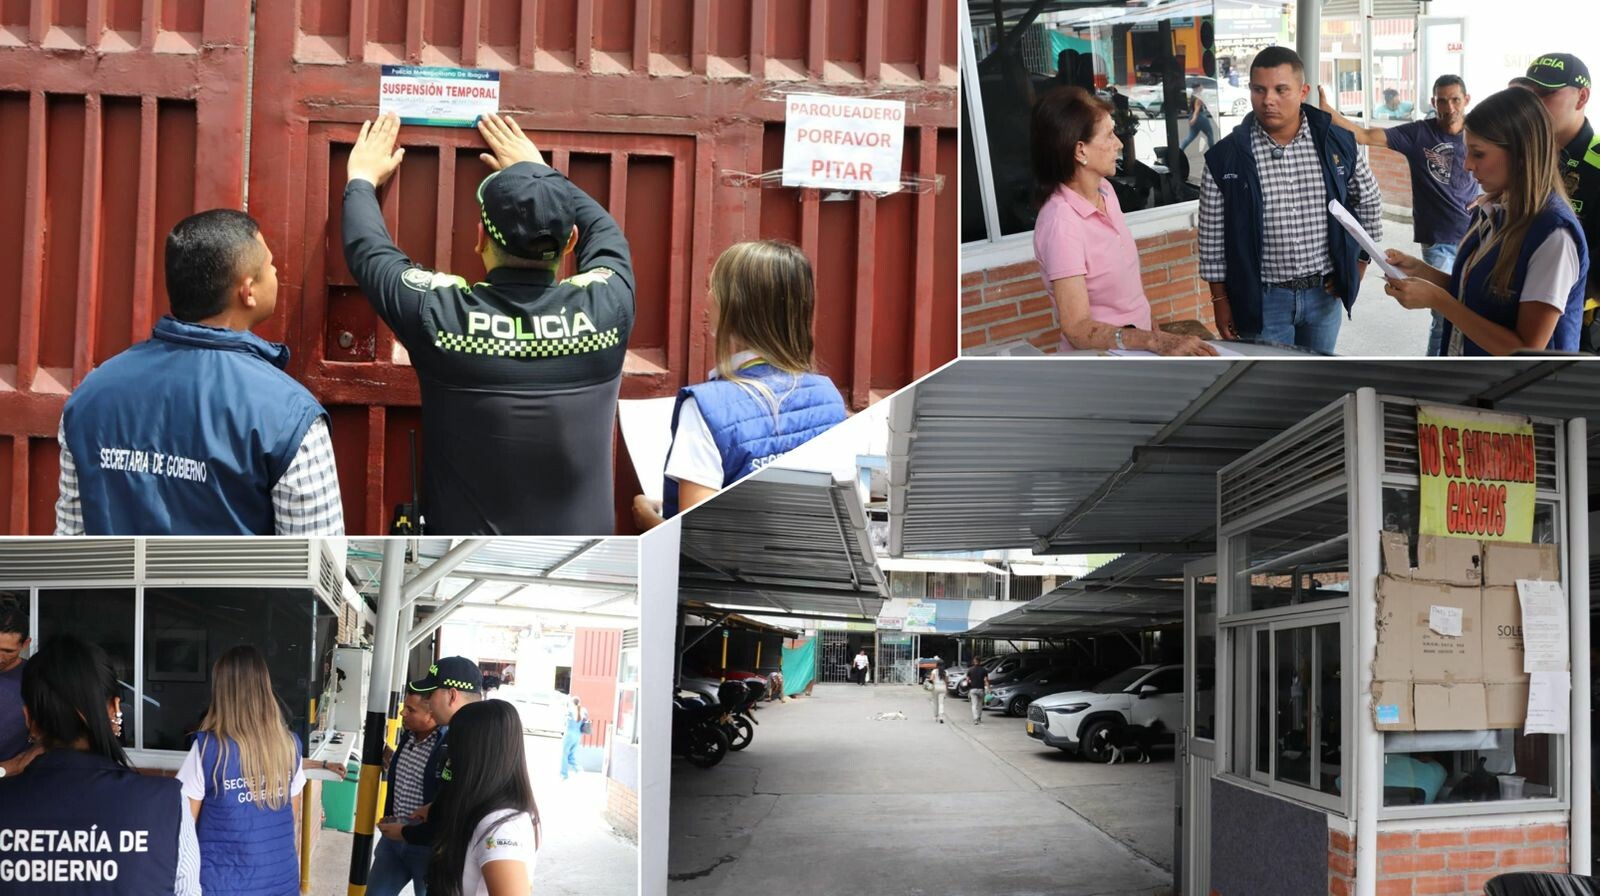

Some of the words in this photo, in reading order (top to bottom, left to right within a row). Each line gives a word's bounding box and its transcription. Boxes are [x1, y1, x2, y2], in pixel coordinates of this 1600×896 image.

[382, 82, 443, 97] SUSPENSIÓN
[446, 86, 497, 99] TEMPORAL
[797, 128, 891, 148] PORFAVOR
[811, 159, 873, 181] PITAR
[468, 306, 597, 341] POLICÍA
[100, 447, 149, 473] SECRETARIA
[152, 452, 165, 475] DE
[166, 454, 207, 483] GOBIERNO
[1418, 423, 1442, 478] NO
[1442, 425, 1462, 479] SE
[1462, 428, 1535, 484] GUARDAN
[1446, 480, 1507, 537] CASCOS
[0, 824, 112, 852] CRETARÍA
[119, 830, 149, 852] DE
[0, 859, 118, 882] GOBIERNO
